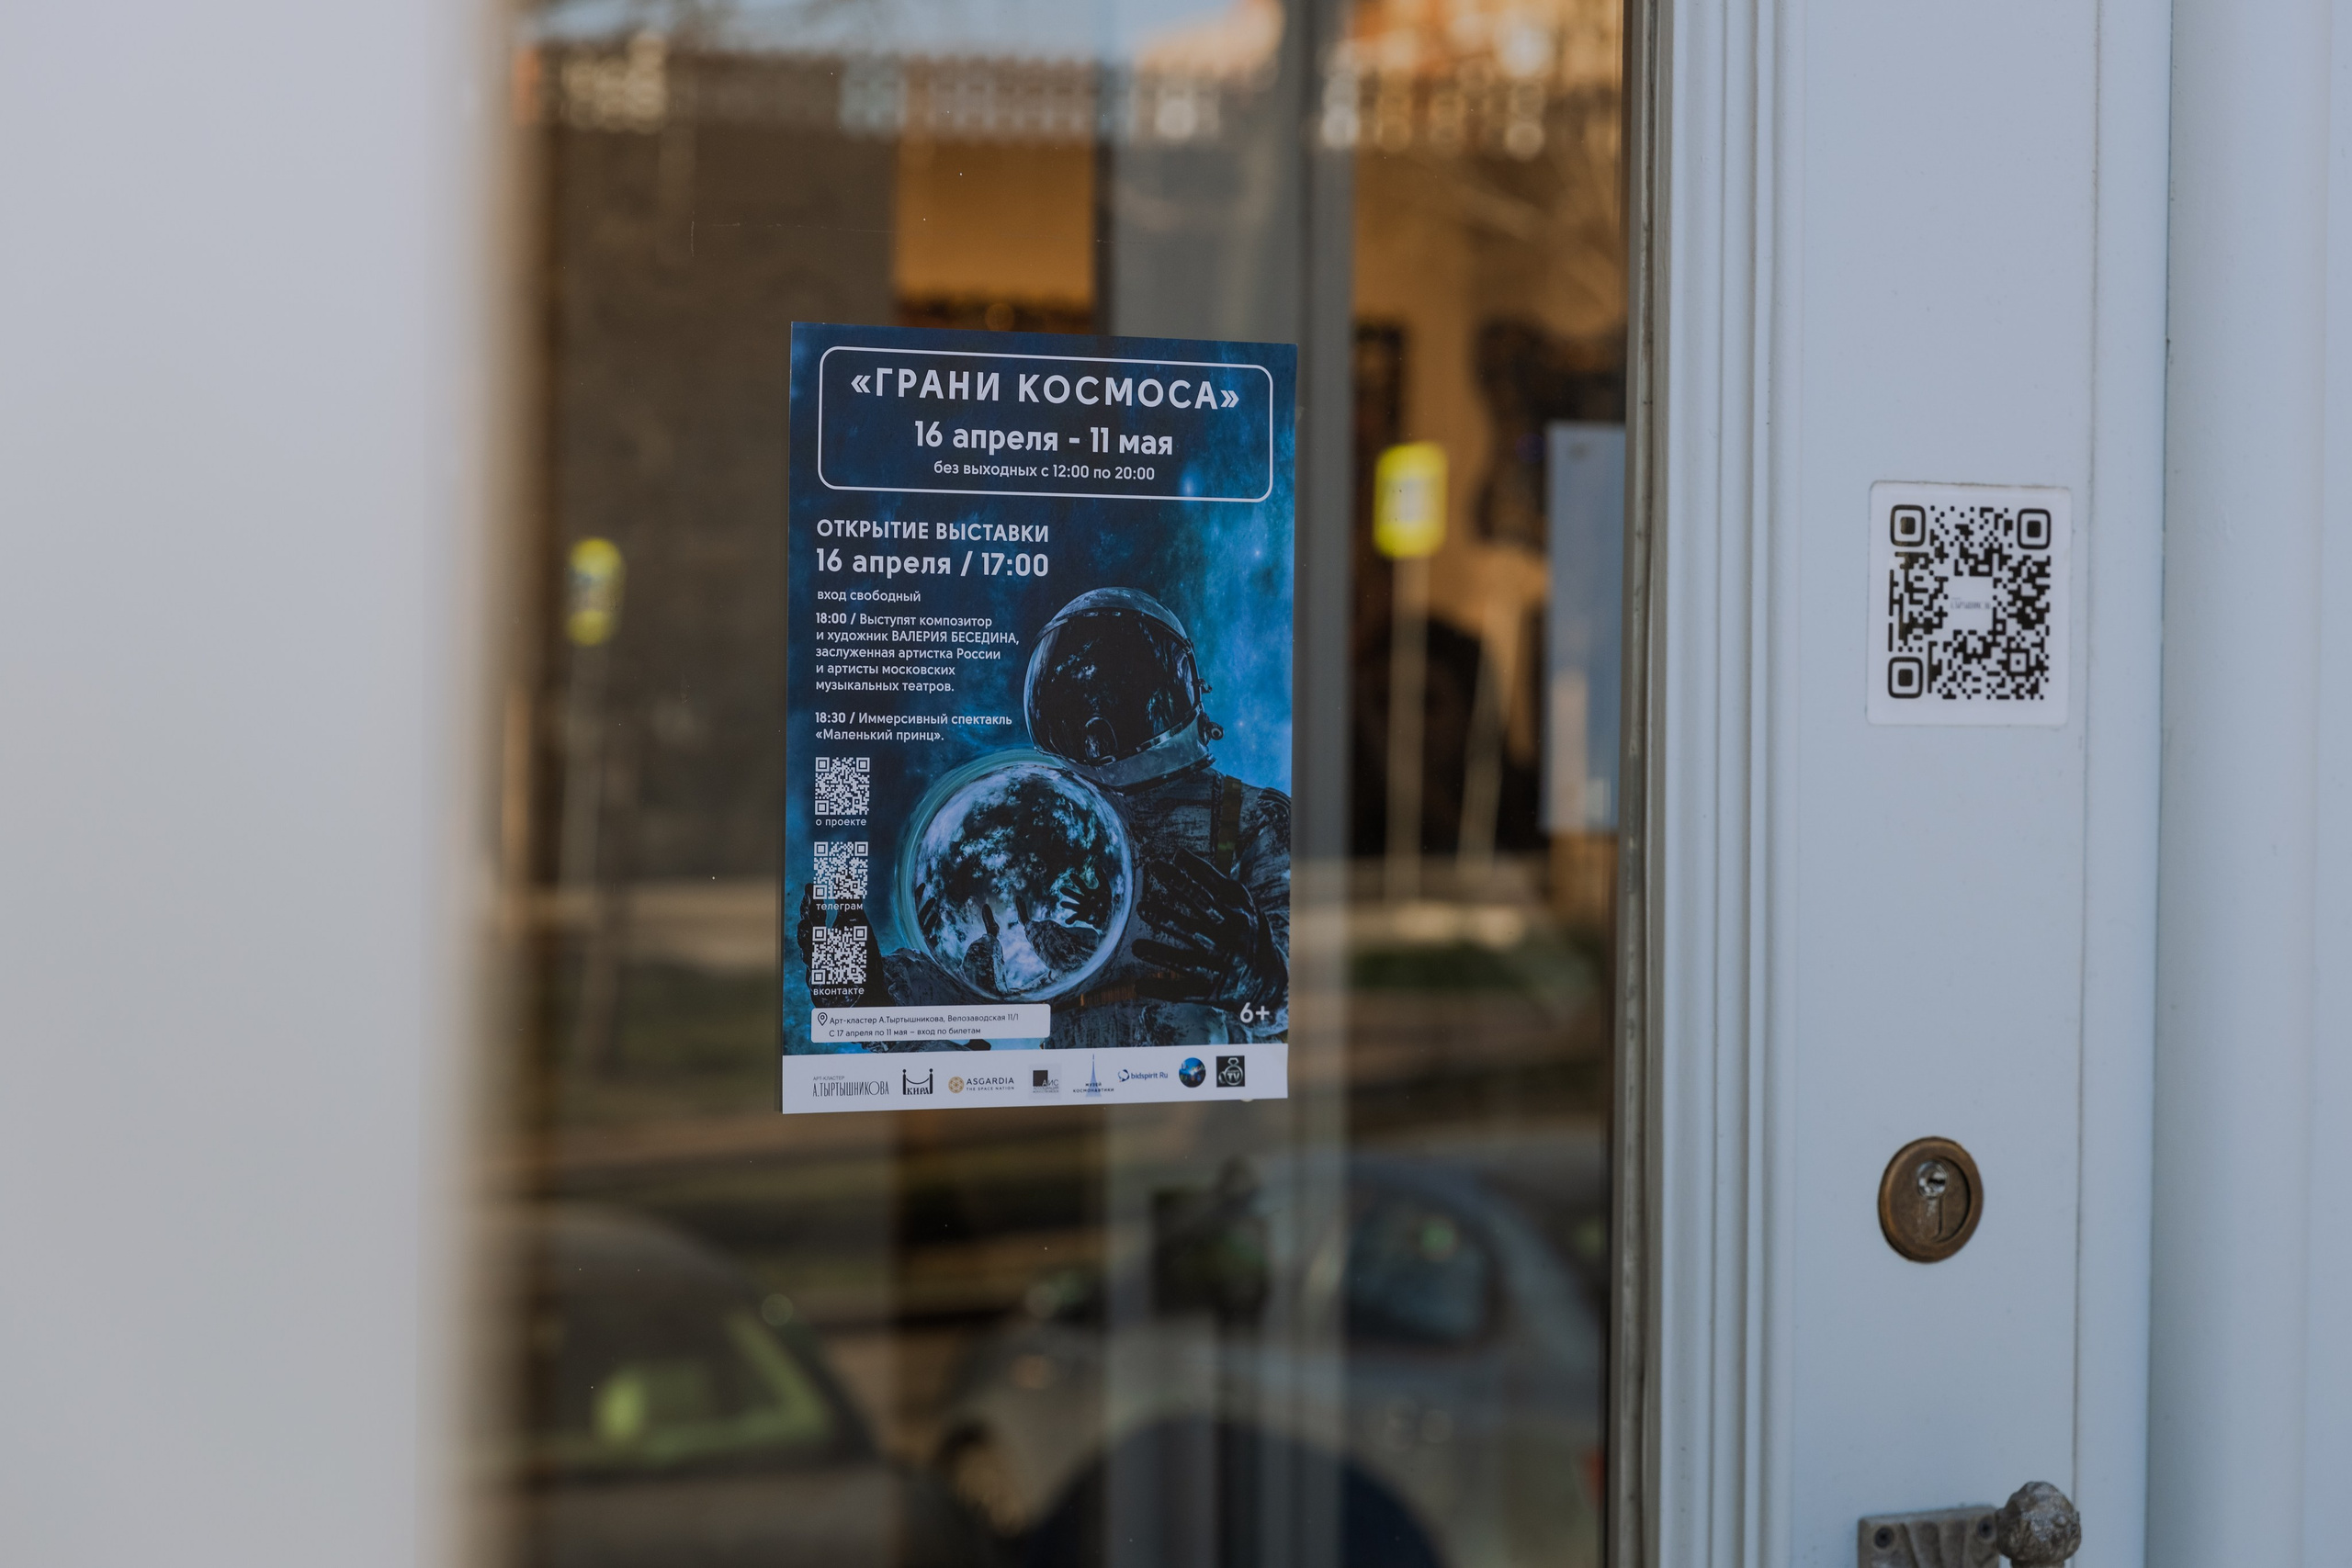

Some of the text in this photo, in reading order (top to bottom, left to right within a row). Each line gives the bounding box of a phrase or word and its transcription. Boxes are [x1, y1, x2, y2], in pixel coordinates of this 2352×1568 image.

[851, 367, 1239, 410] «ГРАНИ КОСМОСА»
[914, 420, 943, 447] 16
[952, 428, 1058, 456] апреля
[1090, 426, 1109, 453] 11
[1119, 434, 1173, 456] мая
[933, 459, 1155, 480] без выходных с 12:00 по 20:00
[817, 518, 1049, 543] ОТКРЫТИЕ ВЫСТАВКИ
[816, 547, 1048, 580] 16 апреля / 17:00
[817, 590, 921, 604] вход свободный
[815, 612, 992, 629] 18:00 / Выступят композитор
[816, 630, 1020, 646] и художник ВАЛЕРИЯ БЕСЕДИНА,
[815, 648, 1001, 661] заслуженная артистка России
[816, 664, 956, 677] и артисты московских
[816, 681, 955, 694] музыкальных театров.
[815, 711, 1012, 726] 18:30 / Иммерсивный спектакль
[815, 728, 944, 743] «Маленький принц».
[815, 818, 867, 828] о проекте
[816, 903, 864, 912] телеграм
[813, 987, 865, 996] вконтакте
[829, 1017, 877, 1026] Арт-кластер
[878, 1015, 945, 1025] А.Тыртышникова,
[947, 1014, 1006, 1022] Велозаводская
[1239, 1001, 1271, 1025] 6+
[828, 1029, 835, 1038] С
[836, 1029, 844, 1037] 17
[845, 1030, 873, 1038] апреля
[886, 1028, 892, 1036] 11
[948, 1027, 981, 1035] билетам
[966, 1077, 1014, 1086] ASGARDIA
[1130, 1071, 1169, 1081] bidspirit Ru
[1227, 1072, 1240, 1081] TV
[812, 1080, 889, 1098] А.ТЫРТЫШНИКОВА
